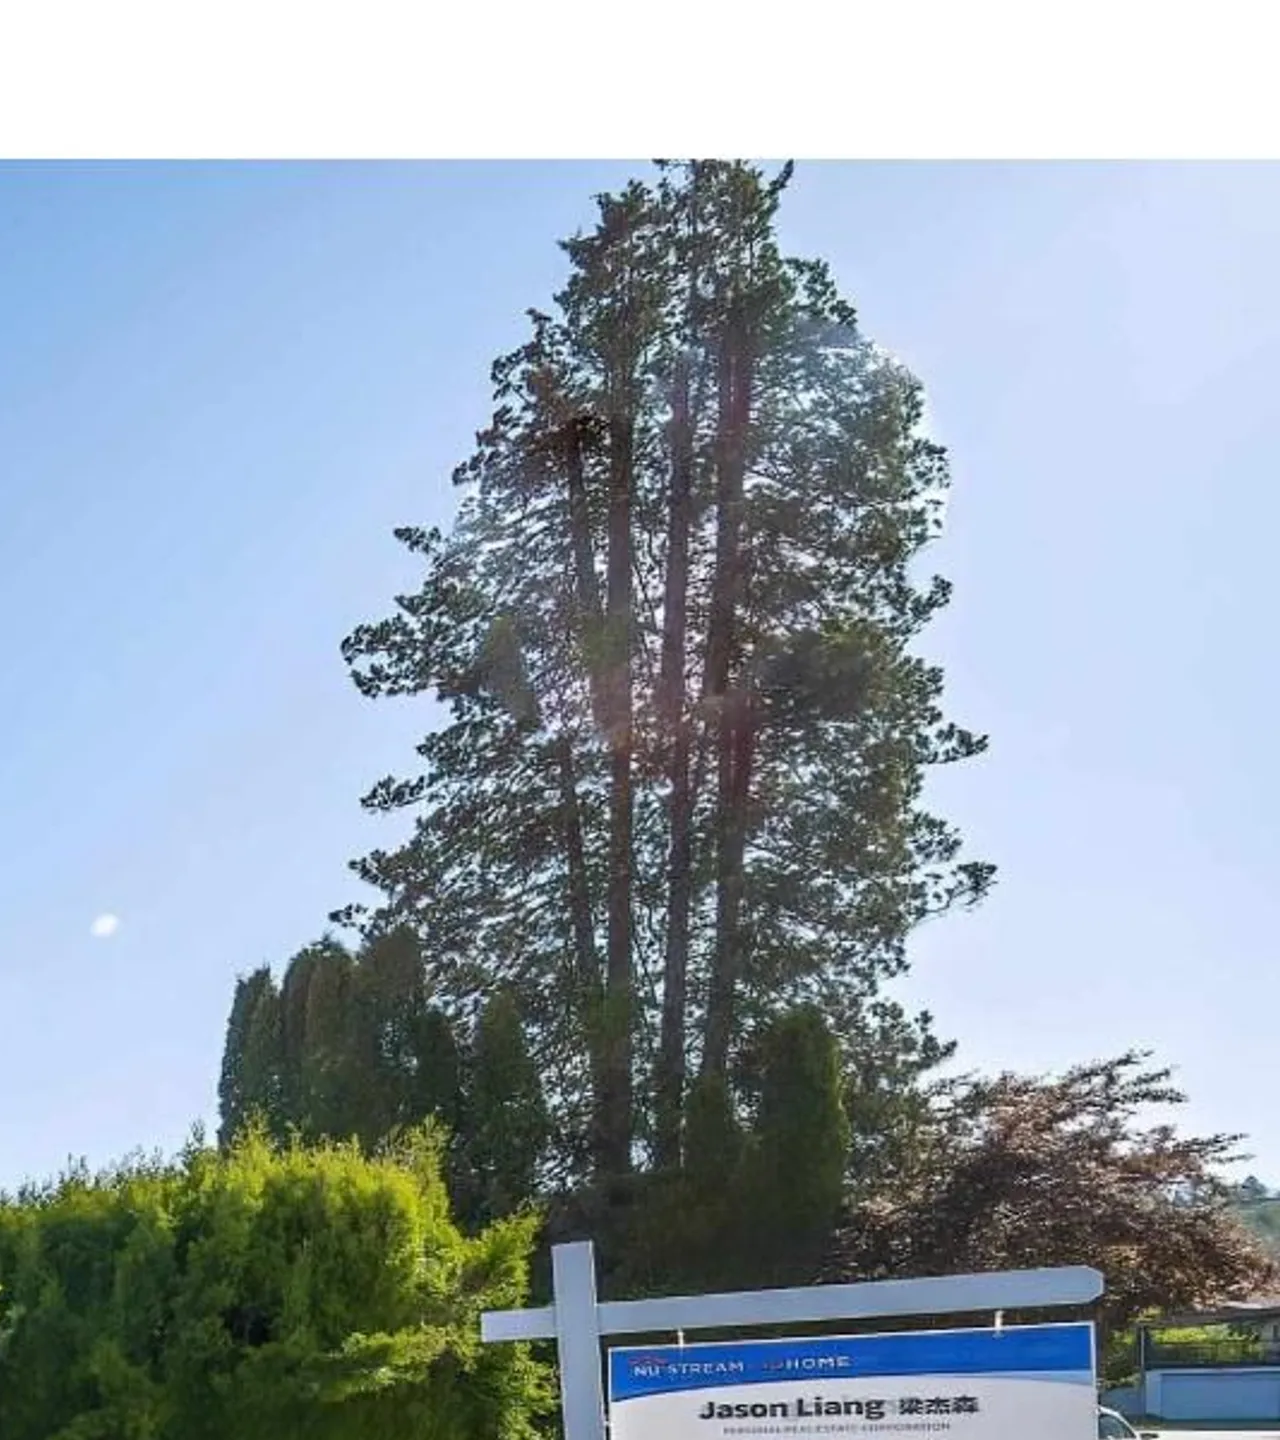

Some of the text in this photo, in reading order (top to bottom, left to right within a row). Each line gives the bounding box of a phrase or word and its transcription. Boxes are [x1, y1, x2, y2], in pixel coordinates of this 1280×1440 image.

[667, 1360, 745, 1375] STREAM
[699, 1396, 886, 1420] Jason Liang
